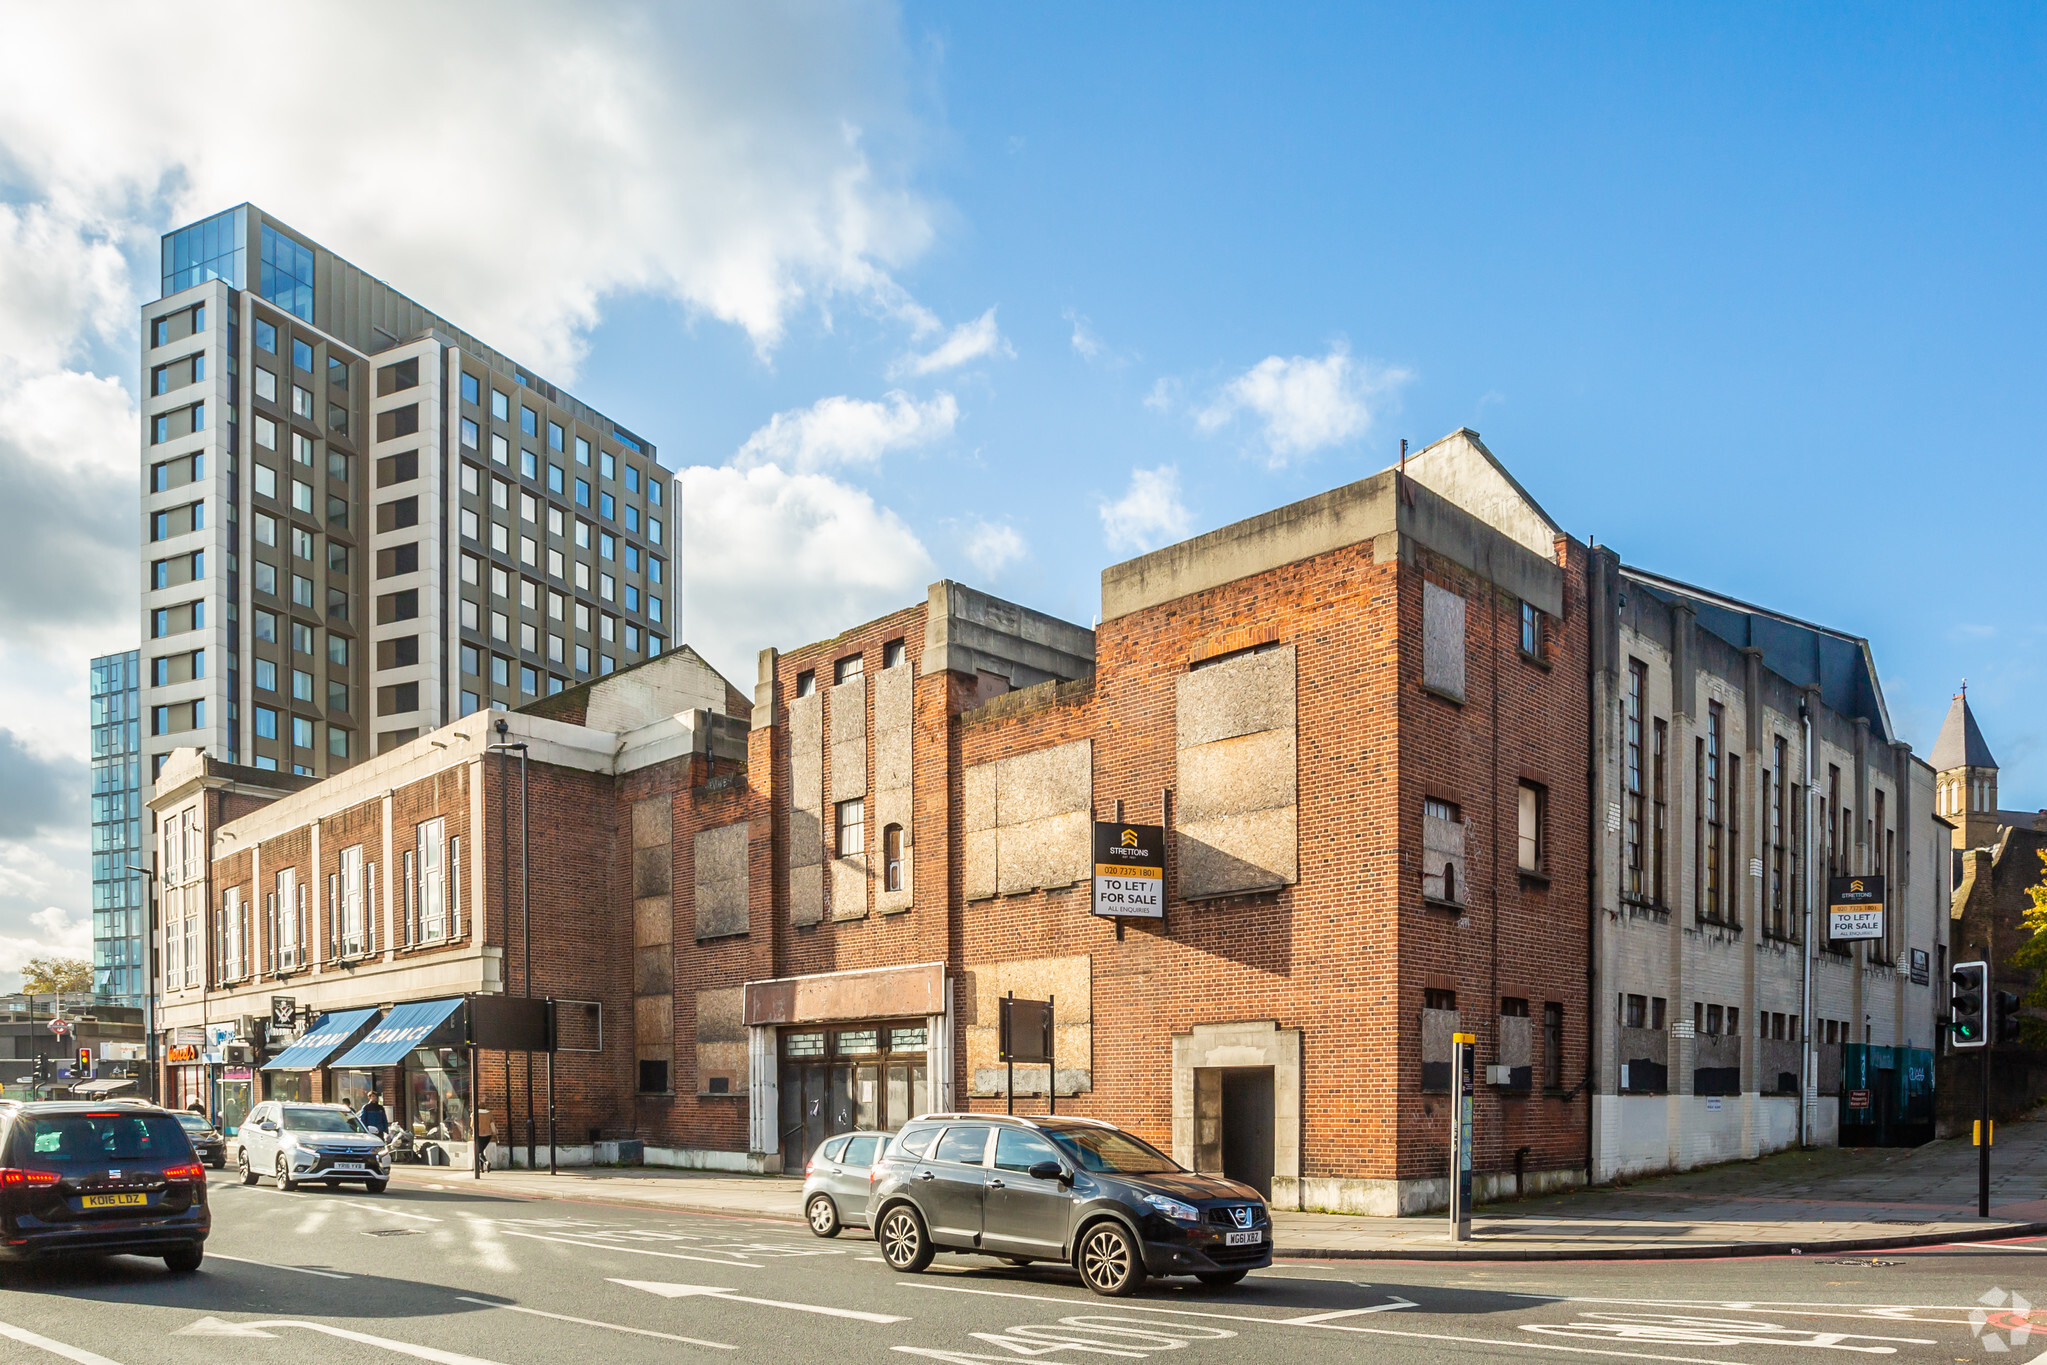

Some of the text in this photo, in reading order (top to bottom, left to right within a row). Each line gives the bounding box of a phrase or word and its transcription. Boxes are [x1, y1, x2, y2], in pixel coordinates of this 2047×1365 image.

[1110, 847, 1148, 856] STRETTONS
[1104, 866, 1155, 877] 020 7375 1801
[1104, 880, 1153, 892] TO LET /
[1101, 893, 1157, 905] FOR SALE
[1120, 906, 1150, 914] ENQUIRIES
[1856, 922, 1878, 930] SALE
[291, 1032, 349, 1048] SECOND
[364, 1024, 433, 1044] CHANCE
[118, 1194, 140, 1204] LDZ
[1231, 1232, 1258, 1244] WG61 XBZ
